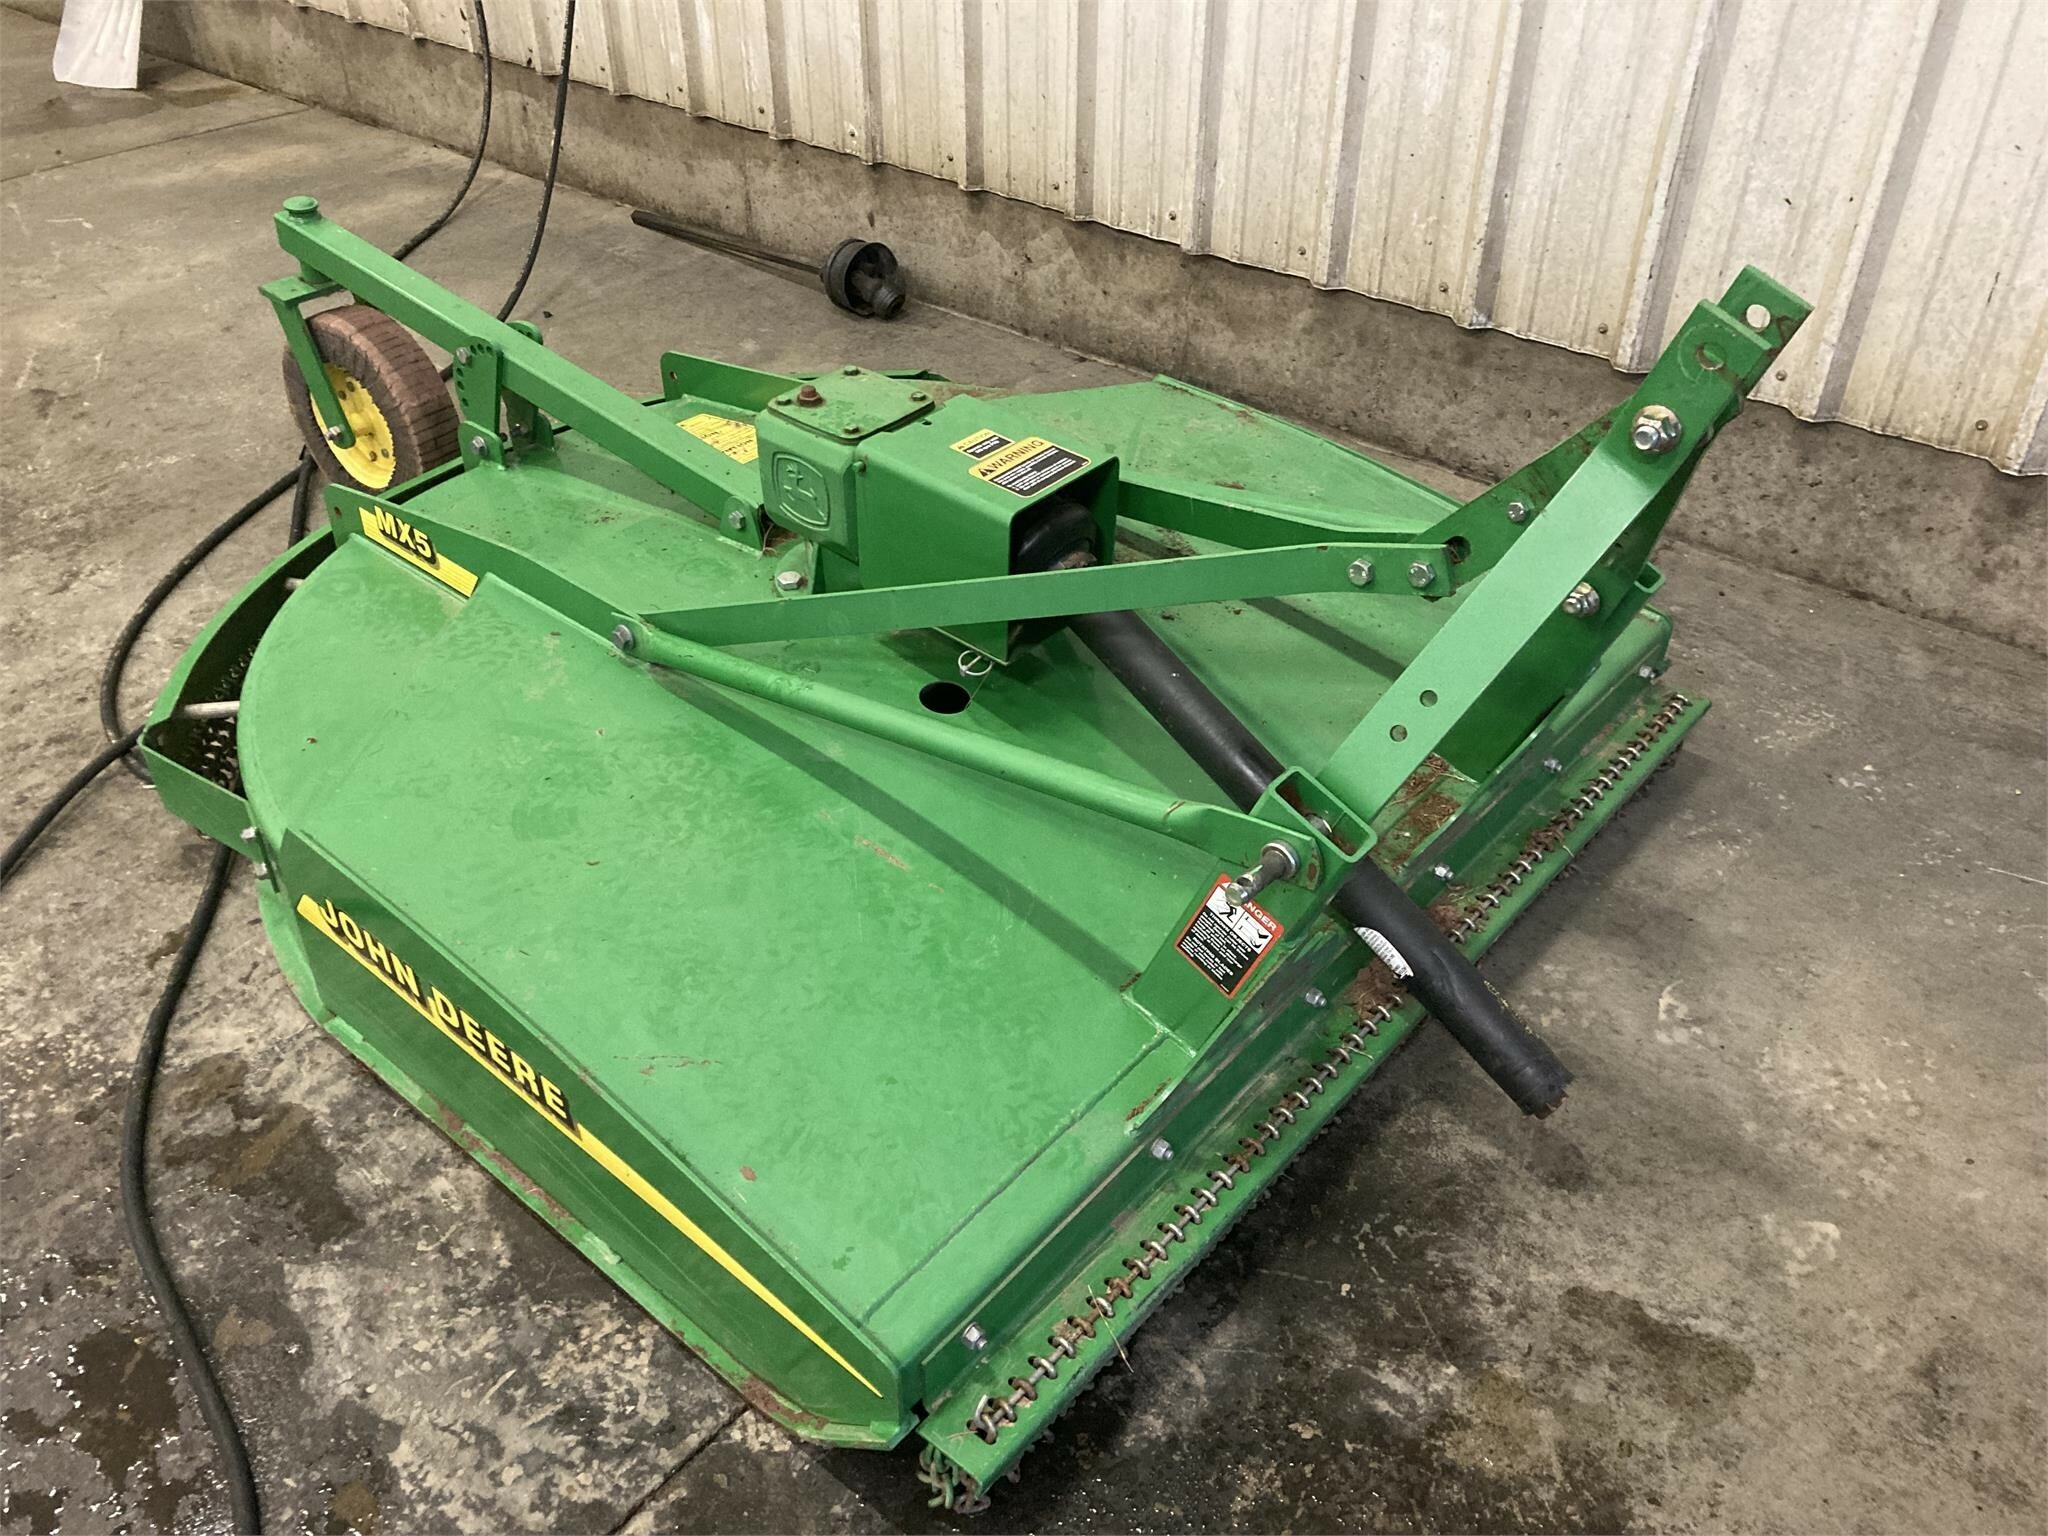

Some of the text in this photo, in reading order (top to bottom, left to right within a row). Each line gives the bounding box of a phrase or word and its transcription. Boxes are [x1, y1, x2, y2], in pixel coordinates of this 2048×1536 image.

[988, 439, 1045, 472] WARNING
[374, 505, 432, 558] MX5
[318, 898, 567, 1120] JOHN DEERE
